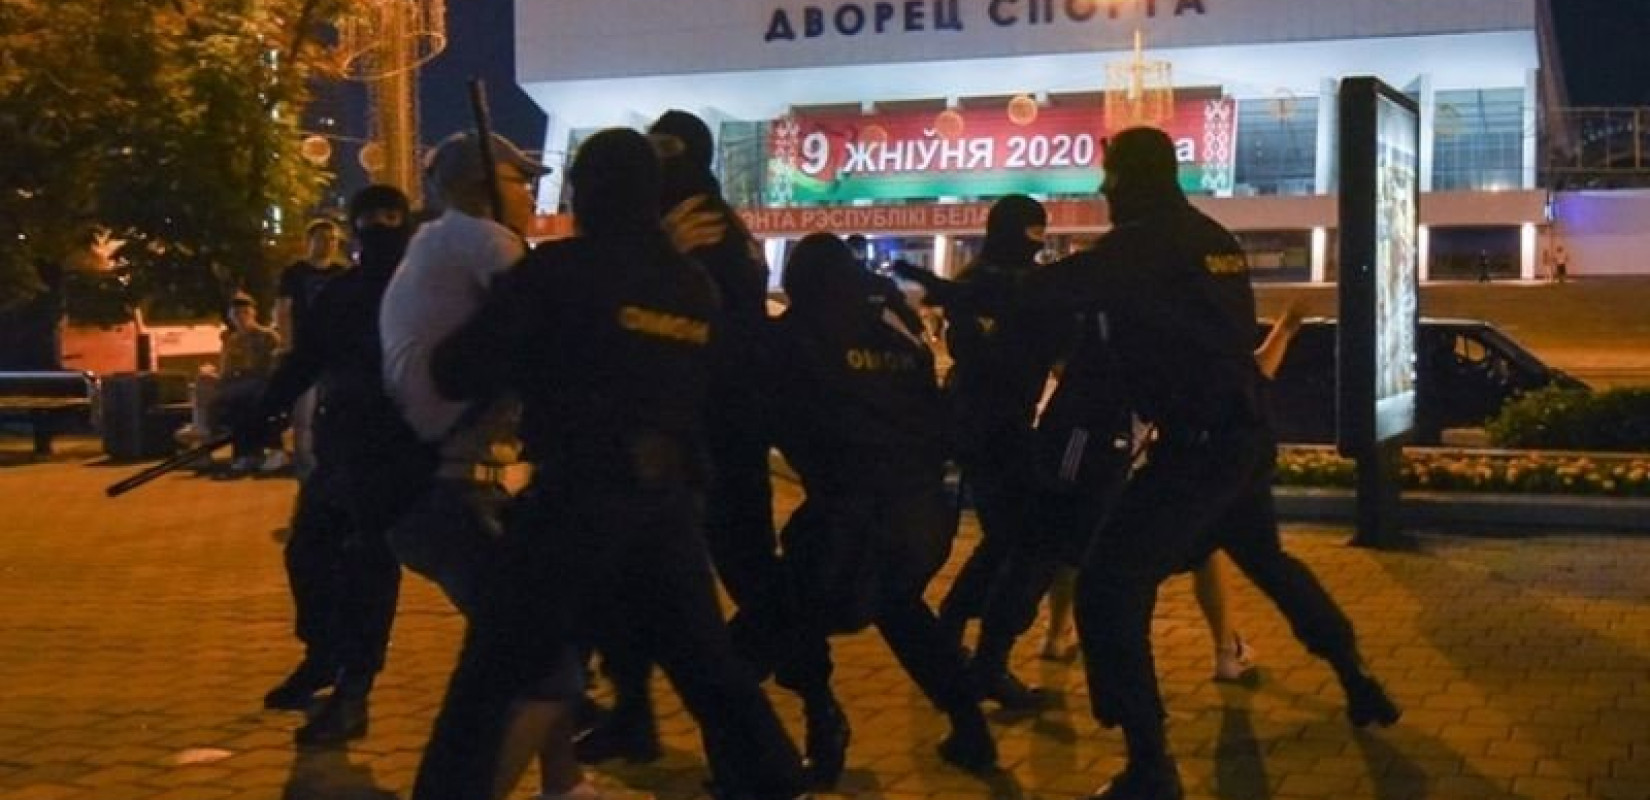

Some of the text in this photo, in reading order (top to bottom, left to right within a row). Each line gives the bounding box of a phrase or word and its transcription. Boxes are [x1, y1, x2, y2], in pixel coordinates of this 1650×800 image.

[764, 0, 963, 42] ДВОРЕЦ
[801, 127, 1094, 174] 9 ЖНІЎНЯ 2020
[740, 210, 795, 231] ЭНТА
[933, 206, 989, 227] БЕЛА
